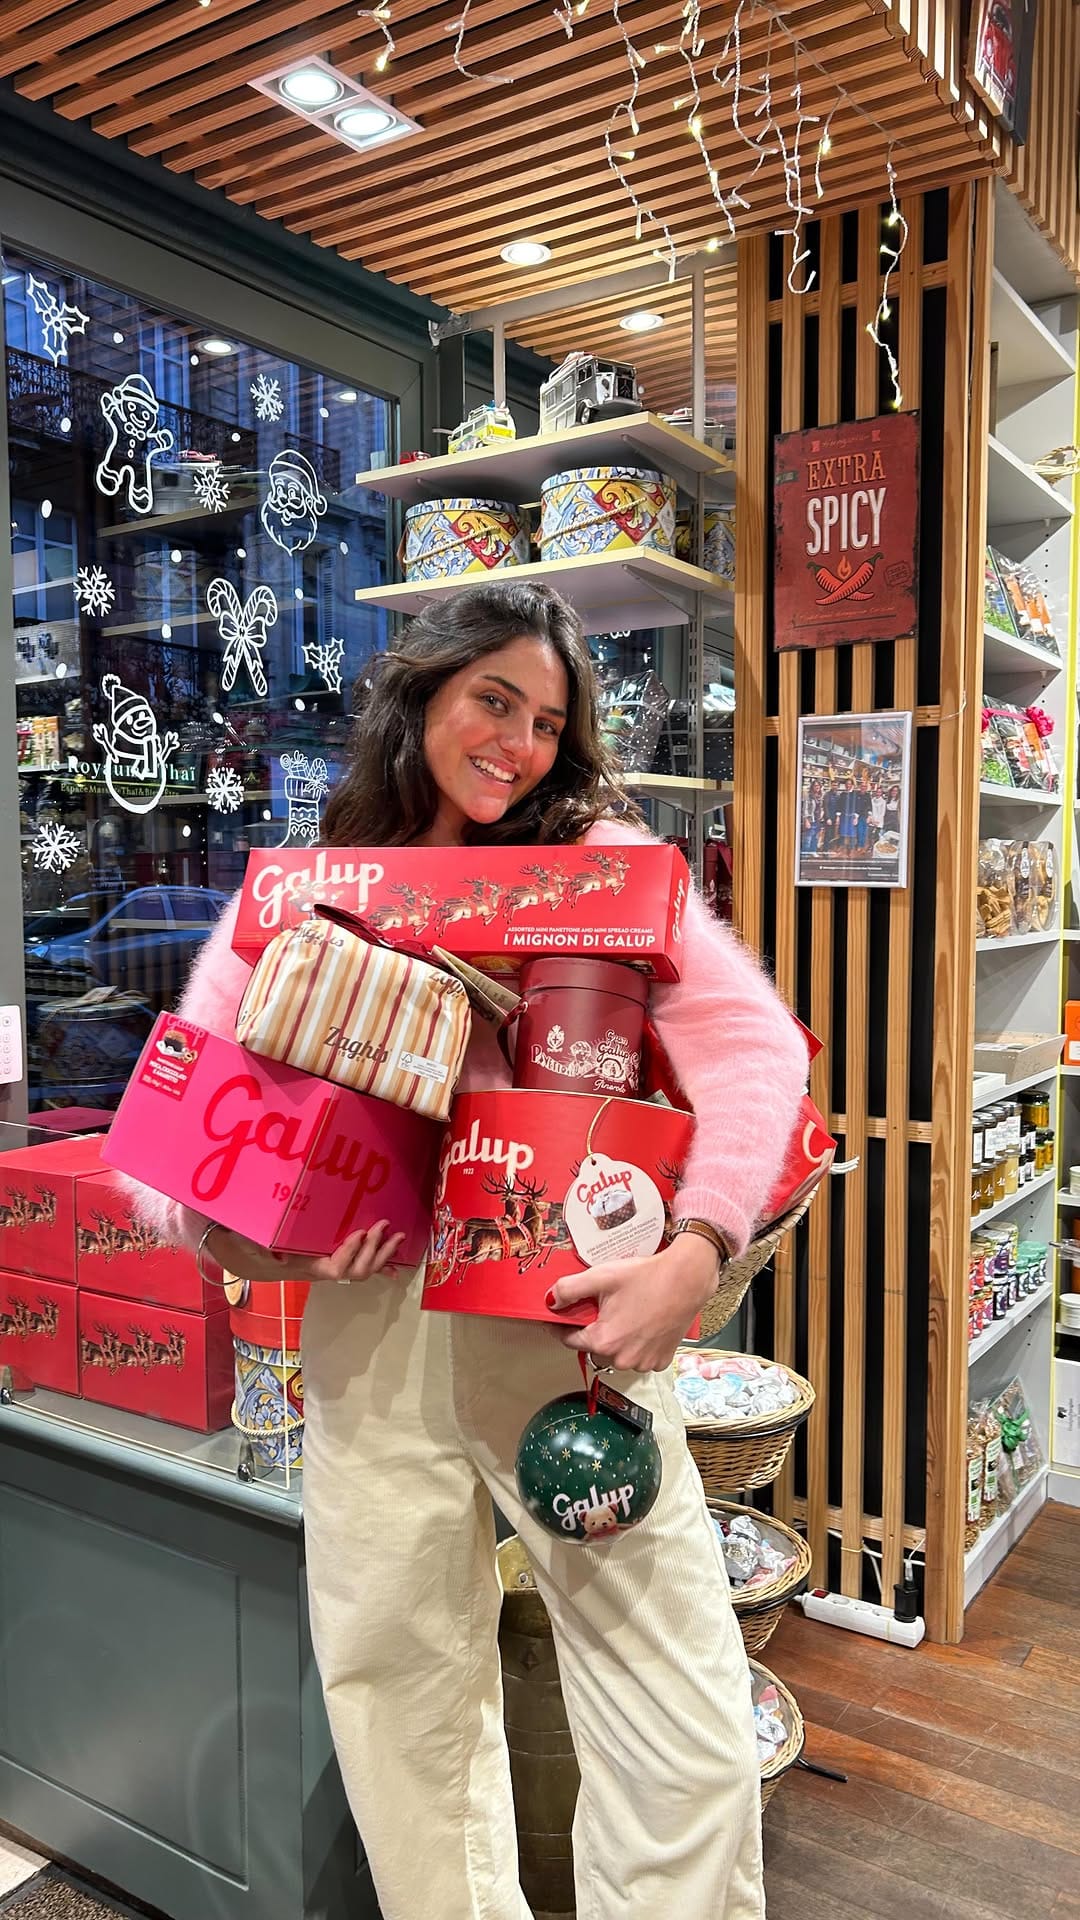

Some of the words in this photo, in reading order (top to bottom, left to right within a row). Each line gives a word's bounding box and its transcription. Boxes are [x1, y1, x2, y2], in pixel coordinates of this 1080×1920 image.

[807, 450, 886, 491] EXTRA
[806, 487, 887, 556] SPICY
[40, 754, 60, 772] Le
[68, 755, 149, 780] Royu
[252, 851, 385, 929] Galup
[504, 933, 509, 946] I
[512, 933, 579, 947] MIGNON
[583, 934, 599, 947] DI
[603, 934, 656, 948] GALUP
[323, 1026, 389, 1063] Zaghis
[597, 1042, 632, 1063] Galup
[191, 1074, 391, 1246] Galup
[271, 1182, 311, 1211] 1922
[577, 1169, 632, 1215] Galup
[552, 1484, 635, 1531] Galup
